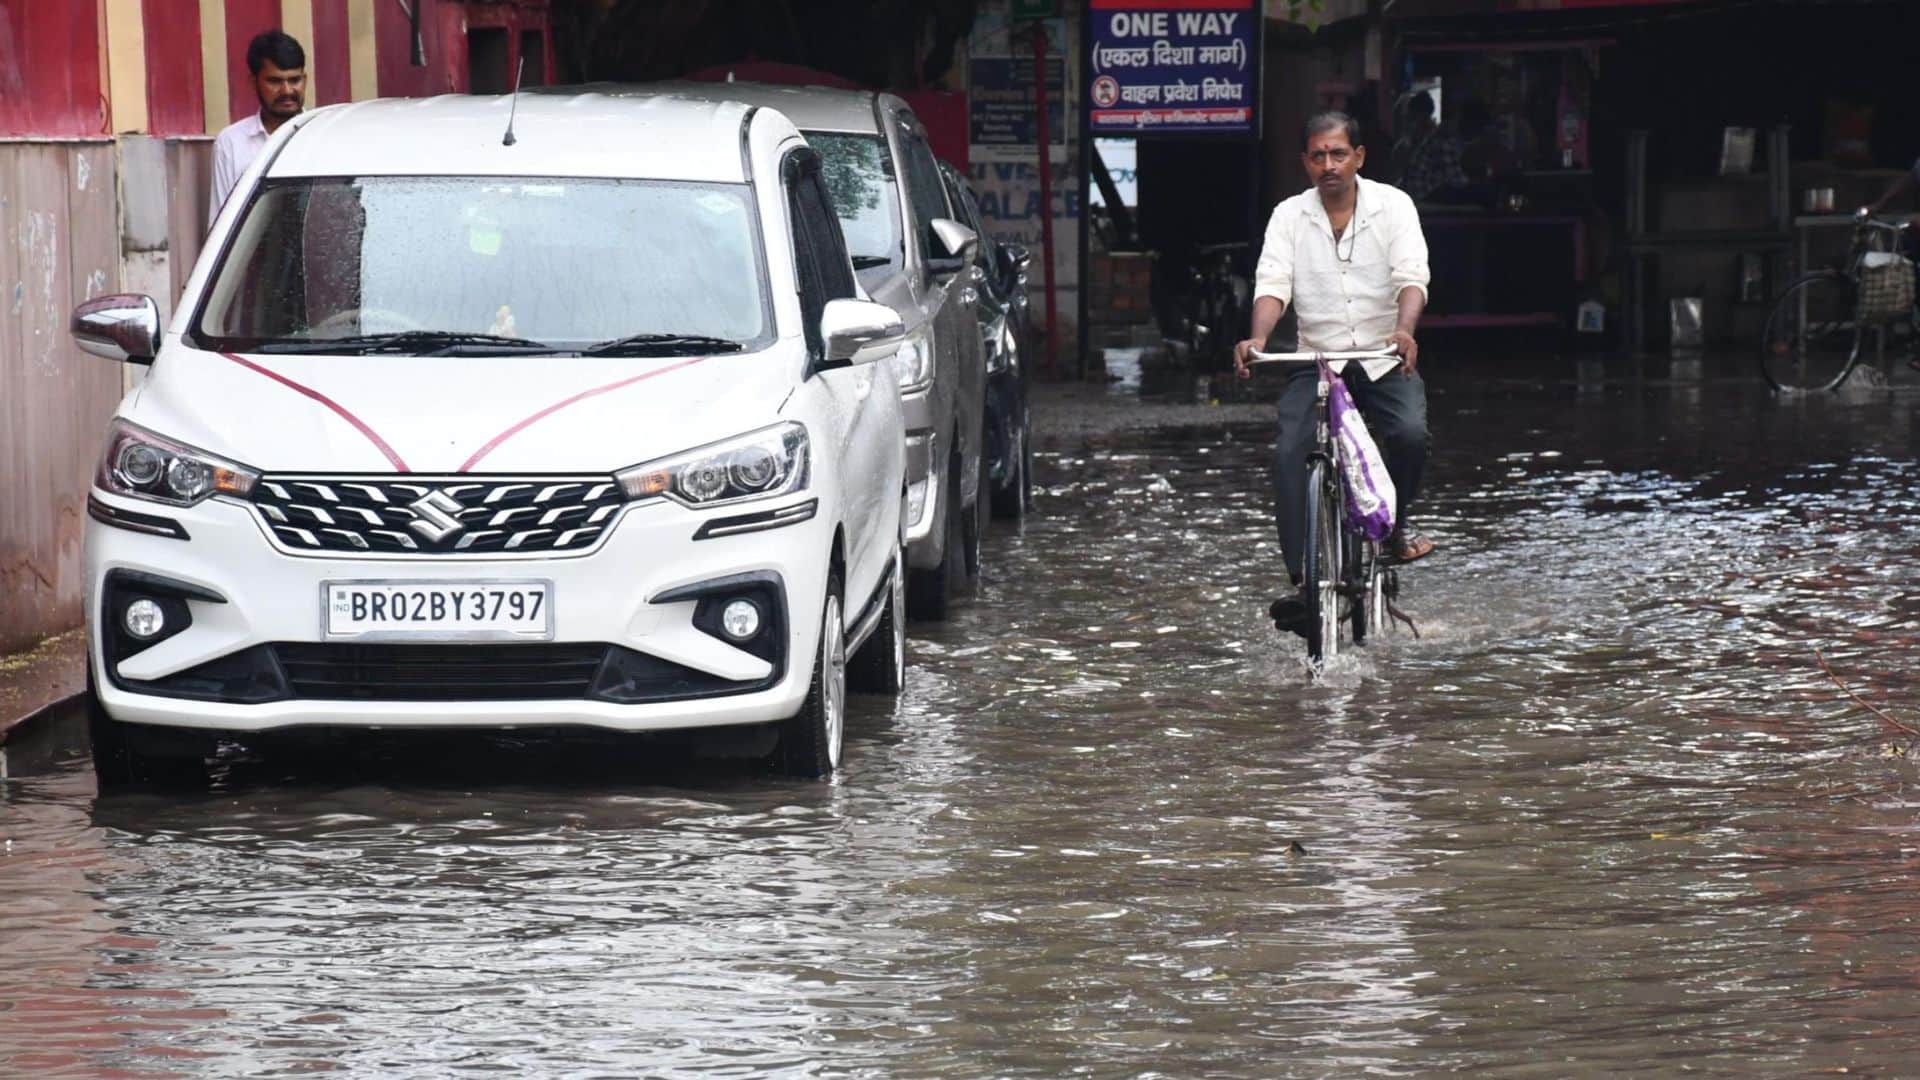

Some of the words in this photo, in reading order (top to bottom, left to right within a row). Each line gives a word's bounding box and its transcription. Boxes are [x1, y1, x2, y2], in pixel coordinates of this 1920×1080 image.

[1110, 12, 1168, 37] ONE
[1176, 13, 1238, 36] WAY
[1153, 39, 1195, 66] दिशा
[1121, 84, 1160, 104] वाहन
[1163, 78, 1199, 104] प्रवेश
[1202, 77, 1243, 101] निषेध
[333, 604, 350, 613] IND
[351, 591, 544, 621] BR02BY3797
